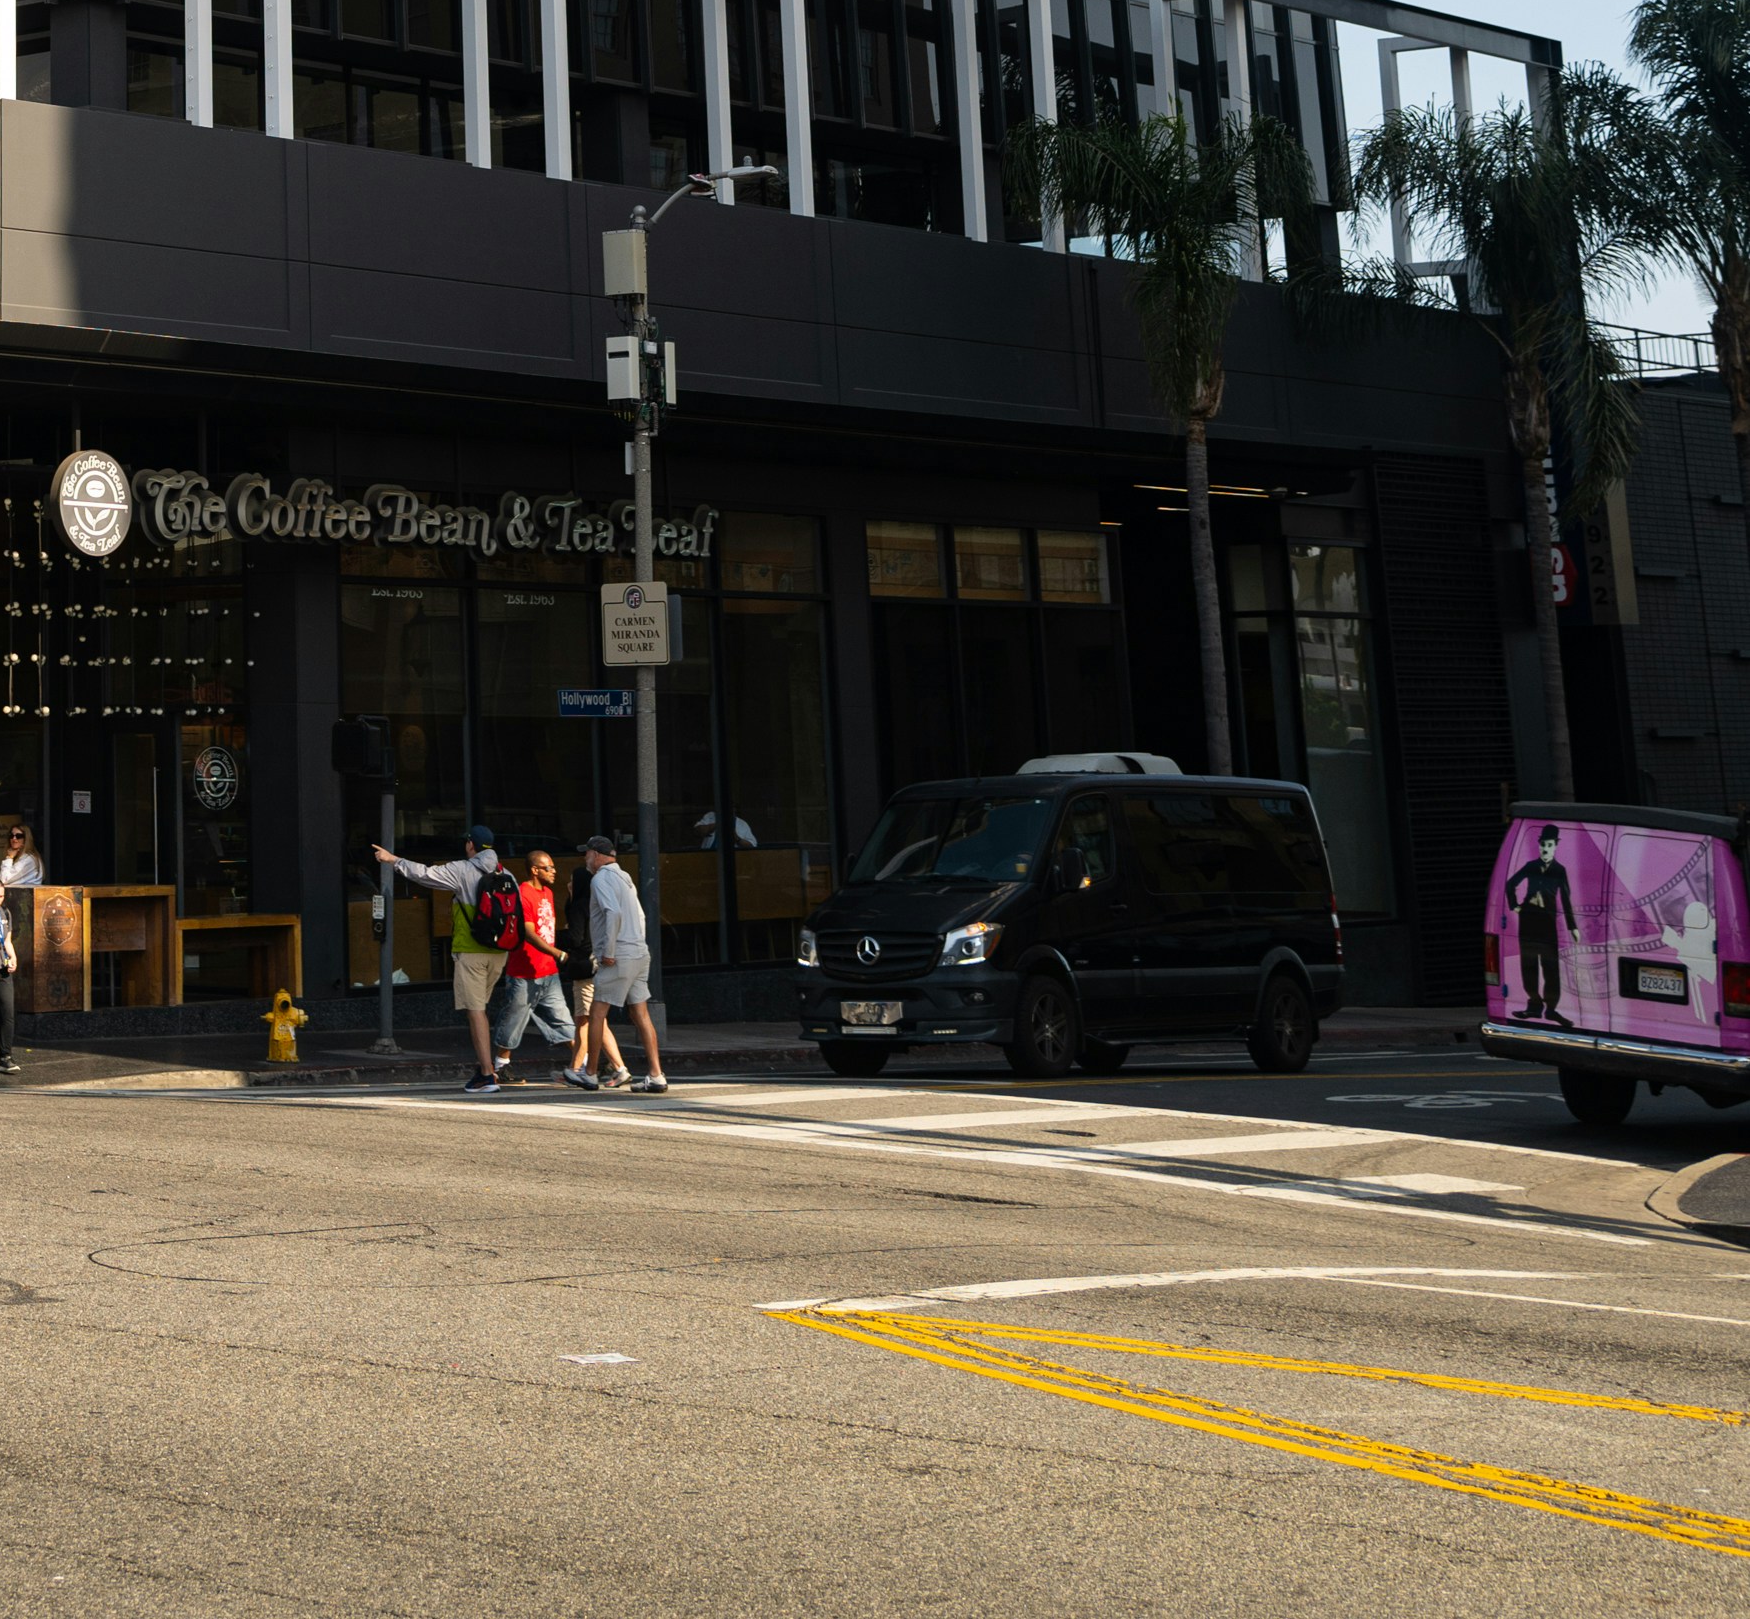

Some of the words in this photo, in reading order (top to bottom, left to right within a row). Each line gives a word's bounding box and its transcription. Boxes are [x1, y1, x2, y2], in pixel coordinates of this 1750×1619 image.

[61, 473, 78, 497] The
[74, 455, 107, 476] Coffee
[106, 461, 126, 503] Bean
[145, 473, 227, 541] The
[236, 477, 371, 542] Coffee
[376, 488, 497, 557] Bean
[505, 494, 540, 550] &
[545, 496, 616, 552] Tea
[69, 524, 80, 539] &
[78, 532, 96, 552] Tea
[96, 523, 121, 552] Leaf
[615, 617, 655, 627] CARMEN
[611, 630, 660, 640] MIRANDA
[617, 643, 655, 653] SQUARE
[561, 692, 610, 708] Hollywood
[622, 692, 633, 704] Bl
